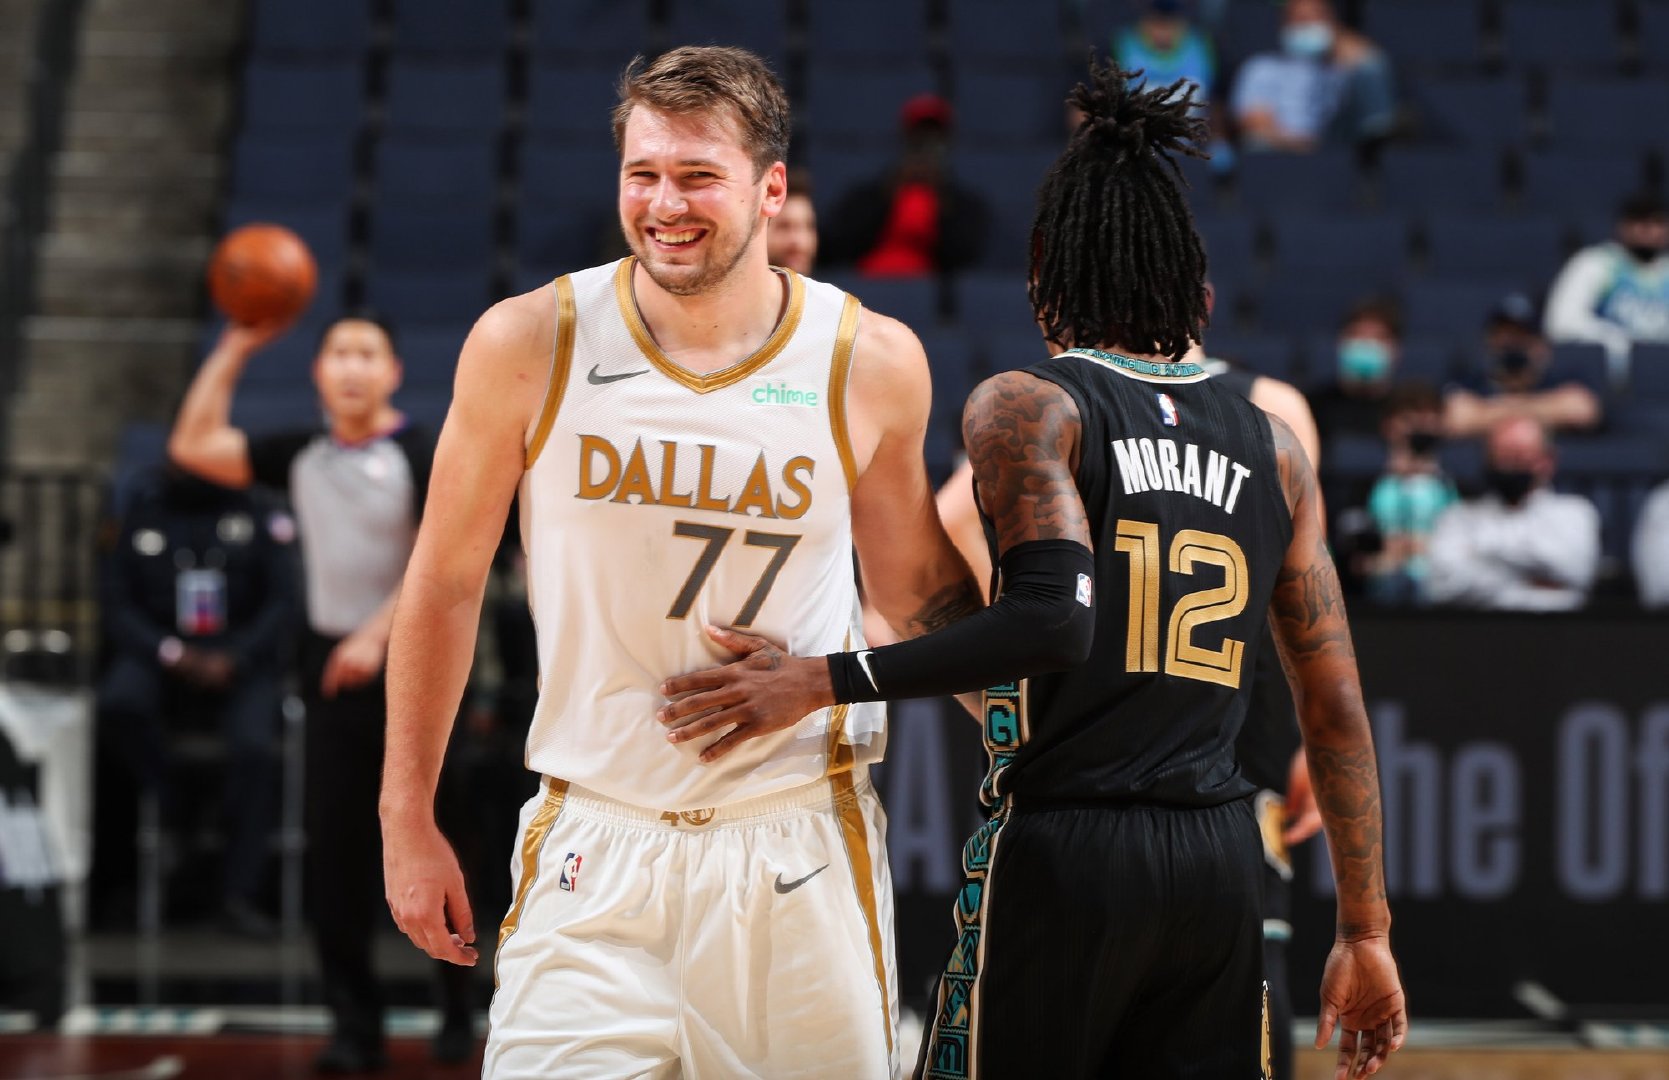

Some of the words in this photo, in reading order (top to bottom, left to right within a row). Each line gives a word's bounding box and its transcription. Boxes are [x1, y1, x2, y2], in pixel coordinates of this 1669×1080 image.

[752, 384, 818, 407] chime
[574, 434, 816, 520] DALLAS
[1111, 437, 1251, 515] MORANT
[665, 520, 803, 629] 77
[1115, 519, 1249, 689] 12
[1312, 702, 1520, 896] he
